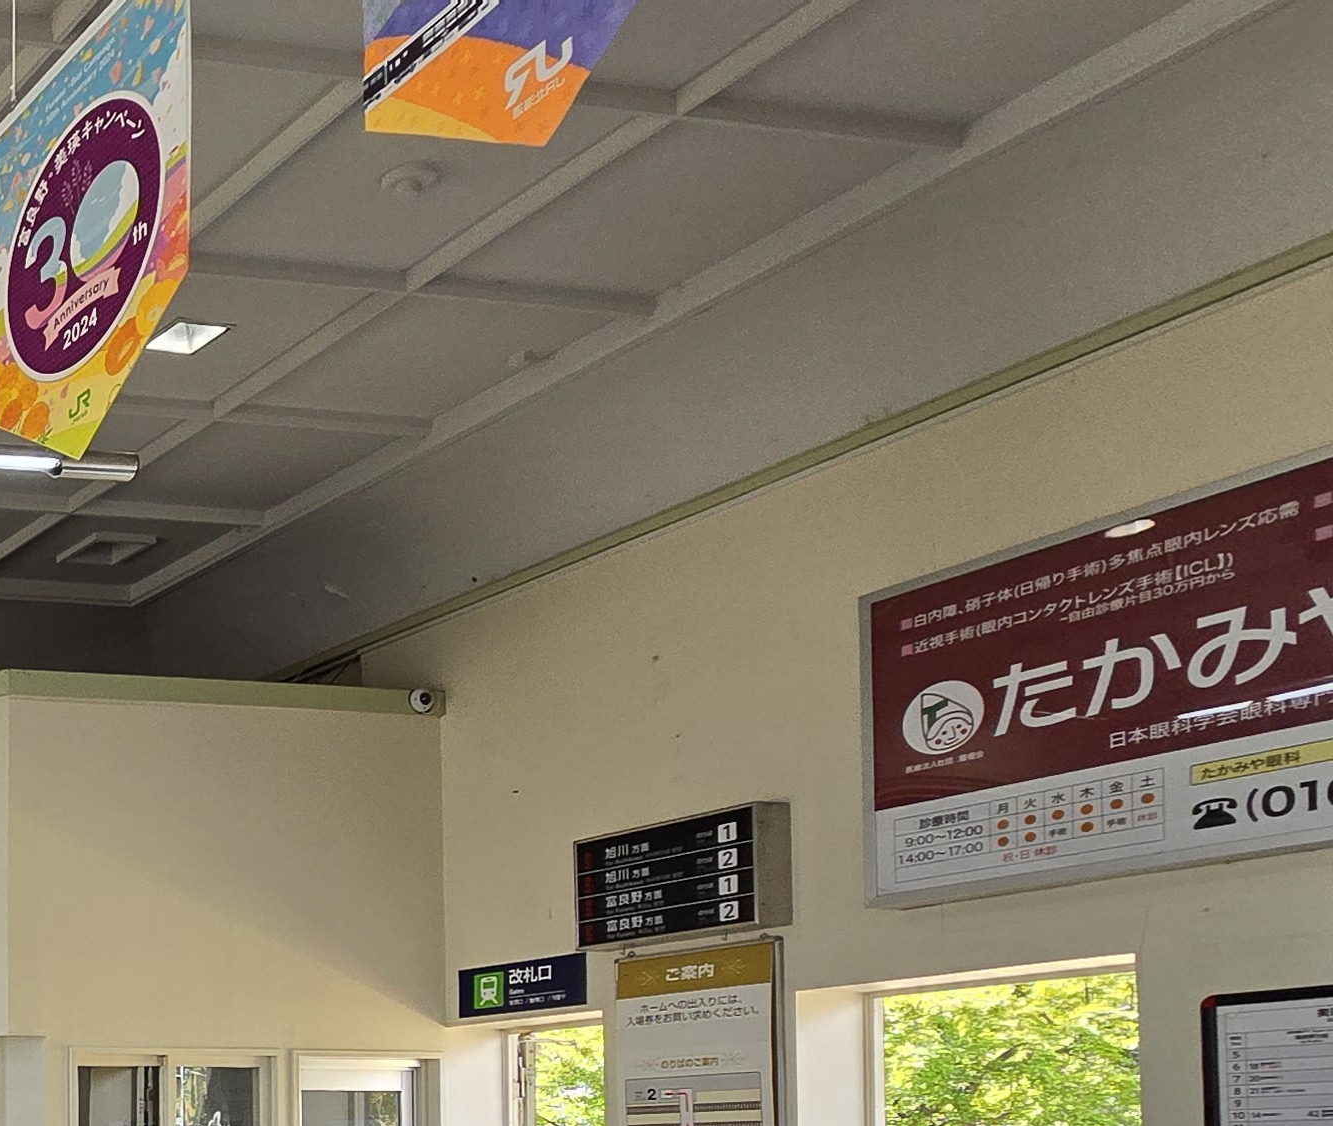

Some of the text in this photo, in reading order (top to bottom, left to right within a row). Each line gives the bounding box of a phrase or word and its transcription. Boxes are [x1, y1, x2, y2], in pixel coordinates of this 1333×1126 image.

[17, 108, 146, 249] 富良野・美瑛キャンペーン
[24, 159, 149, 330] 30 th
[52, 275, 111, 331] Anniversary
[62, 307, 100, 350] 2024
[68, 387, 93, 420] JR
[1200, 751, 1302, 780] たかみや眼科
[919, 774, 1156, 830] 診療時間 月 火 水 木 金 土
[1105, 816, 1127, 829] 手術
[723, 824, 731, 840] 1
[721, 851, 733, 867] 2
[724, 877, 732, 893] 1
[723, 903, 735, 919] 2
[507, 964, 553, 986] 改札口
[664, 964, 715, 982] ご案内
[639, 994, 743, 1013] ホームへの出入りには、
[625, 1006, 760, 1028] 入場券をお買い求めください。
[1232, 1051, 1241, 1060] 5
[1232, 1063, 1241, 1072] 6
[1232, 1075, 1242, 1084] 7
[646, 1088, 657, 1101] 2
[1233, 1087, 1242, 1096] 8
[1233, 1099, 1242, 1108] 9
[1232, 1111, 1246, 1120] 10
